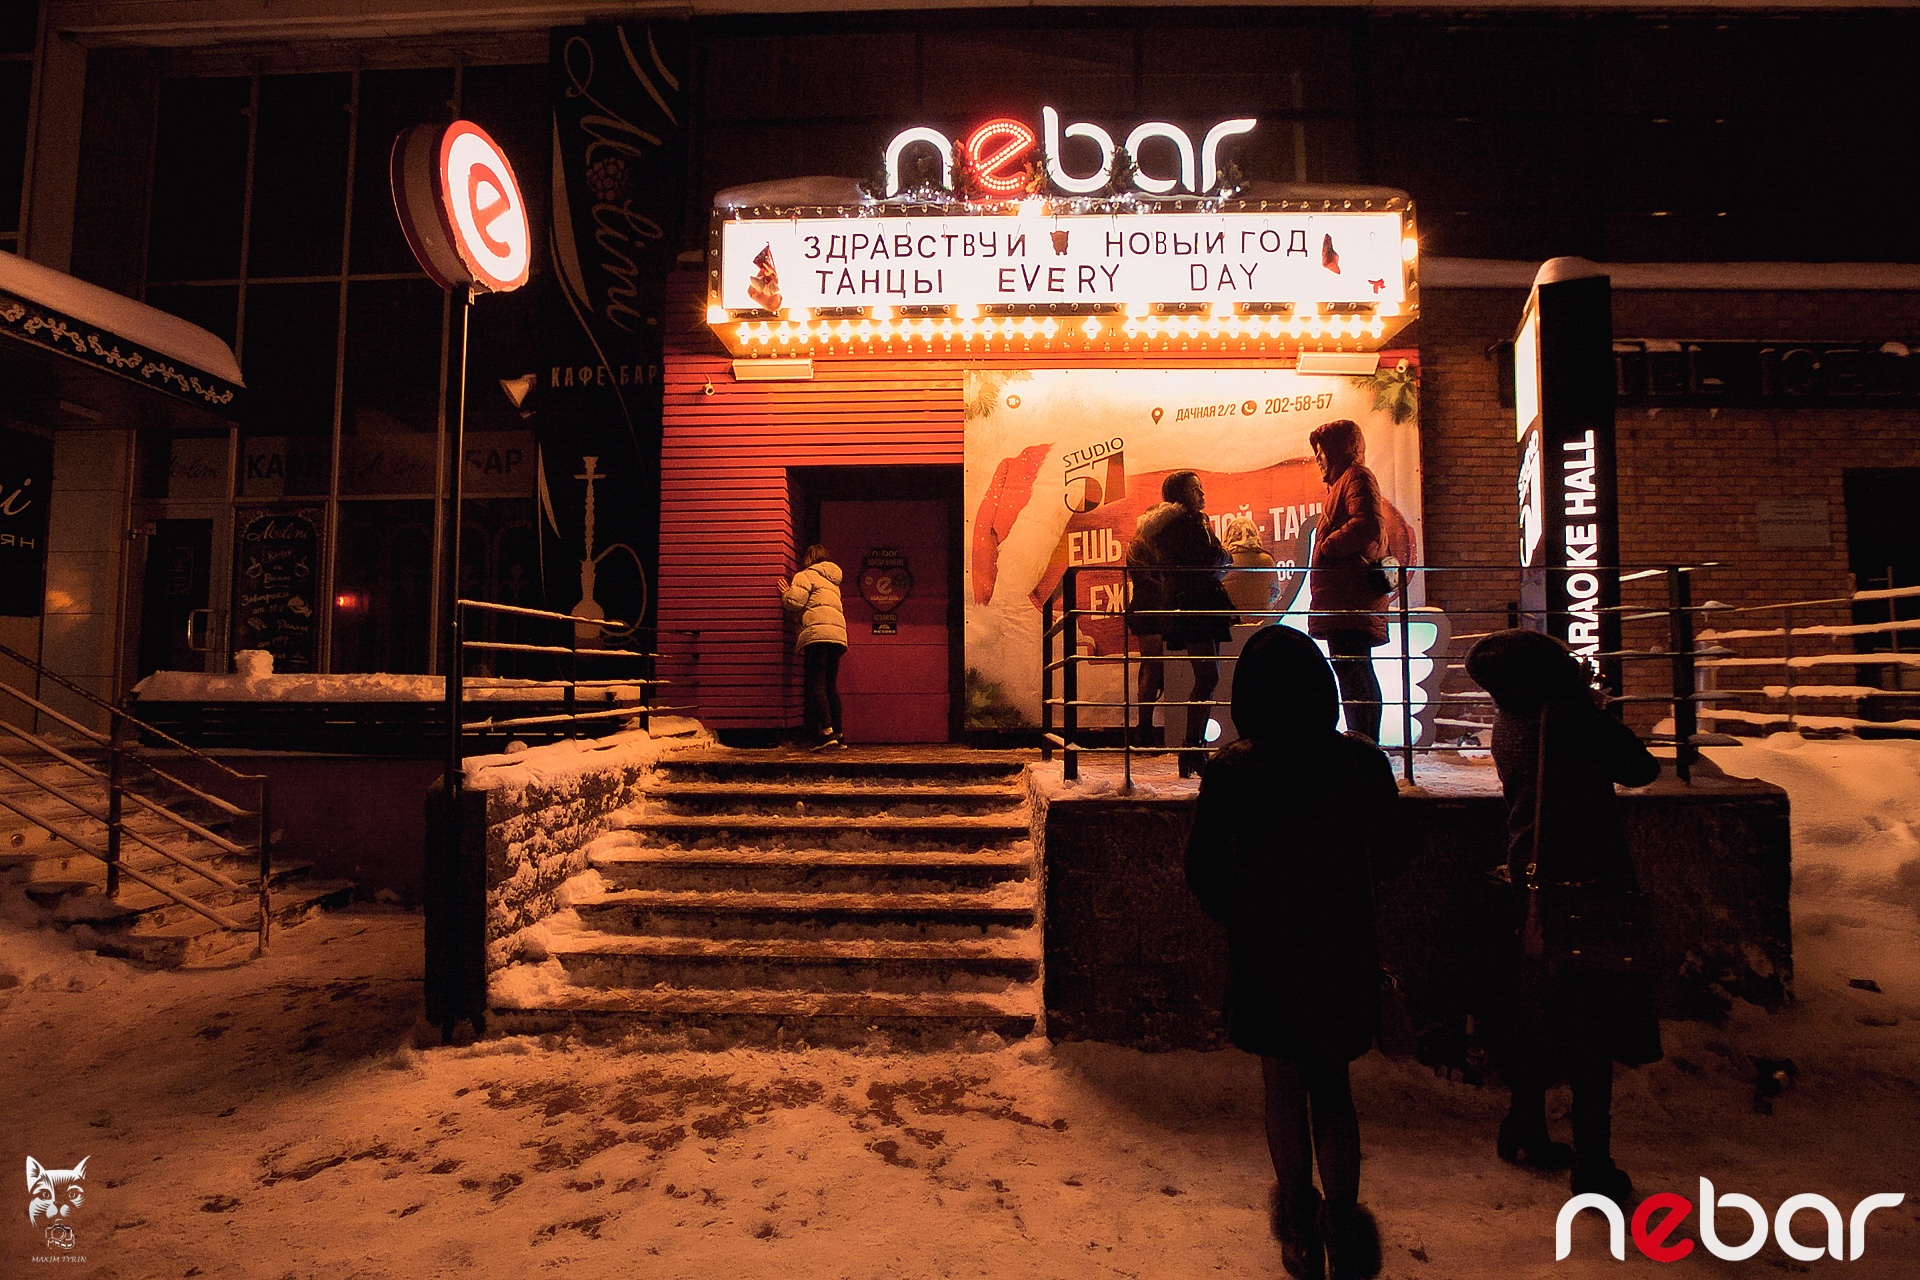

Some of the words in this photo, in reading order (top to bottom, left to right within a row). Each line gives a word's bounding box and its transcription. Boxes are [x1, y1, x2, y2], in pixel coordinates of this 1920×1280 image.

[886, 106, 1257, 198] nebar
[1241, 230, 1308, 257] ГОД
[815, 267, 943, 298] ТАНЦЫ
[999, 263, 1120, 293] EVERY
[1190, 262, 1259, 292] DAY
[551, 366, 607, 388] КАФЕ
[619, 364, 659, 387] БАР
[1176, 405, 1216, 422] ДАЧНАЯ
[1217, 404, 1237, 417] 2/2
[1265, 393, 1333, 415] 202-58-57
[1062, 437, 1124, 468] STUDIO
[1562, 429, 1597, 517] HALL
[1067, 528, 1122, 567] ЕШЬ
[1565, 523, 1601, 690] ARAOKE
